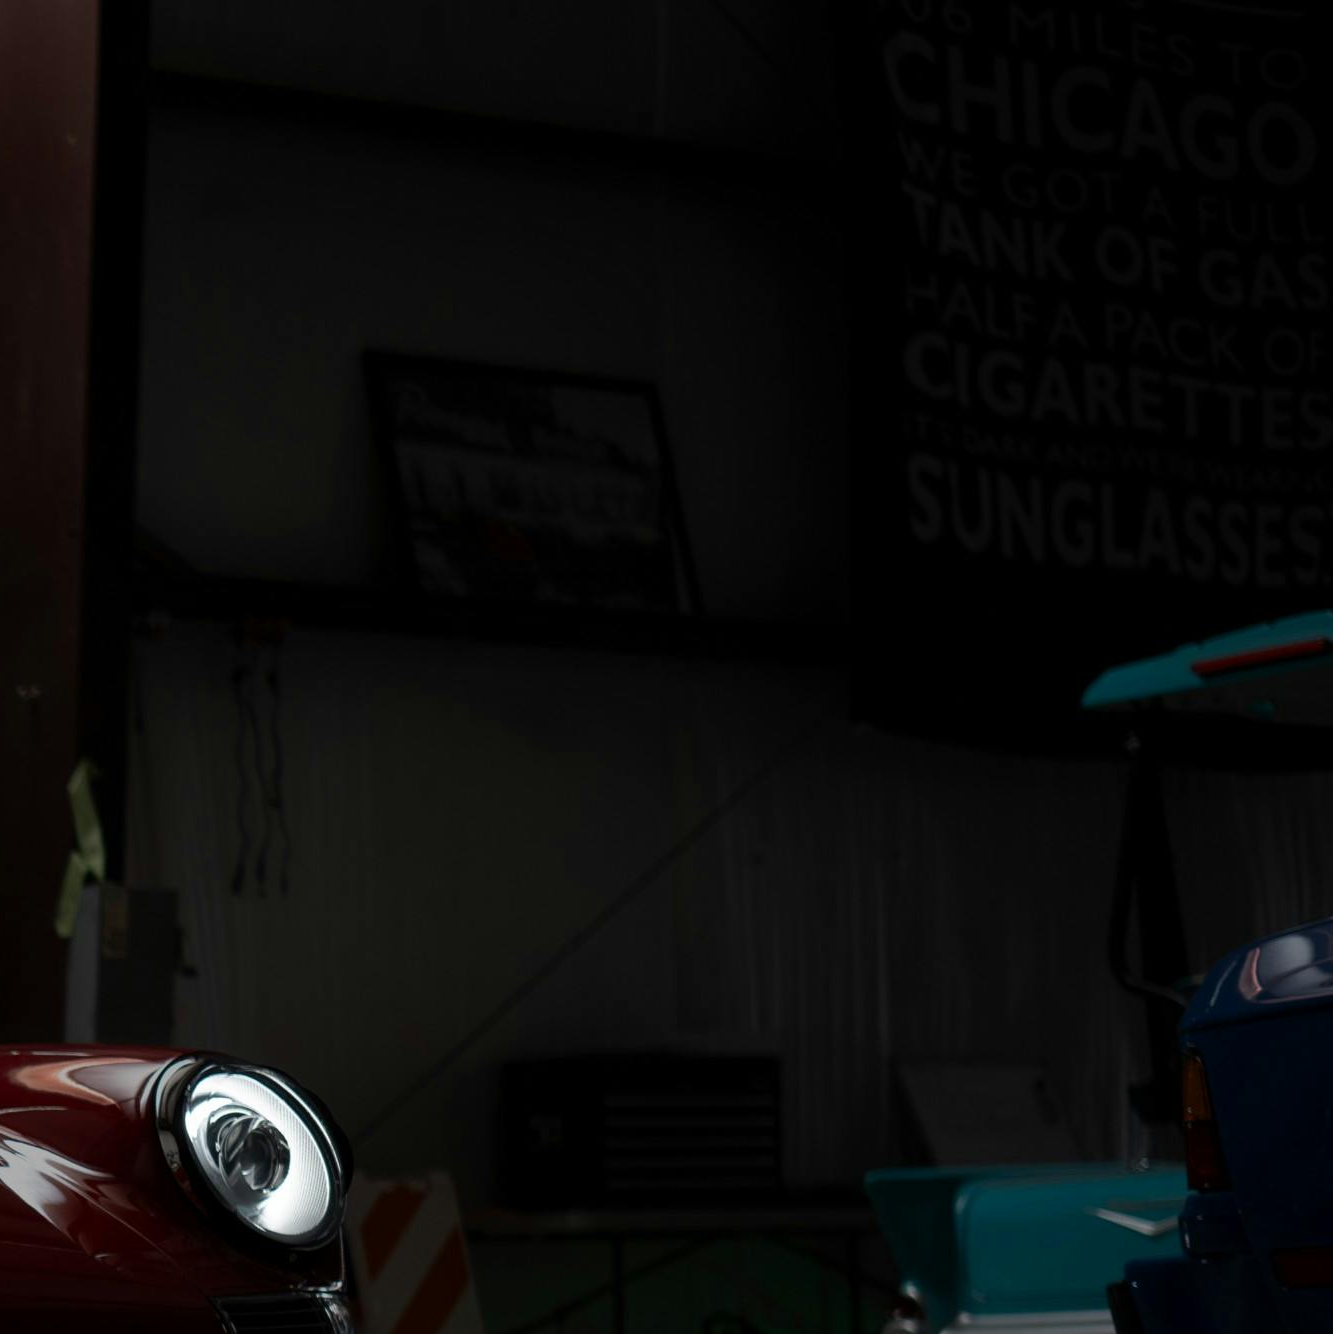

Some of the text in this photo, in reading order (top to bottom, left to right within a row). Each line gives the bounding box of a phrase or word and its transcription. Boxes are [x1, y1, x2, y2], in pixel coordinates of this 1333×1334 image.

[1009, 3, 1195, 76] MILES
[1218, 41, 1307, 88] TO
[883, 29, 1317, 184] CHICAGO
[898, 130, 1325, 243] WE GOT A FULL
[901, 179, 1328, 310] TANK OF GAS
[904, 266, 1327, 376] HALF A PACK OF
[903, 332, 1333, 449] CIGARETTES
